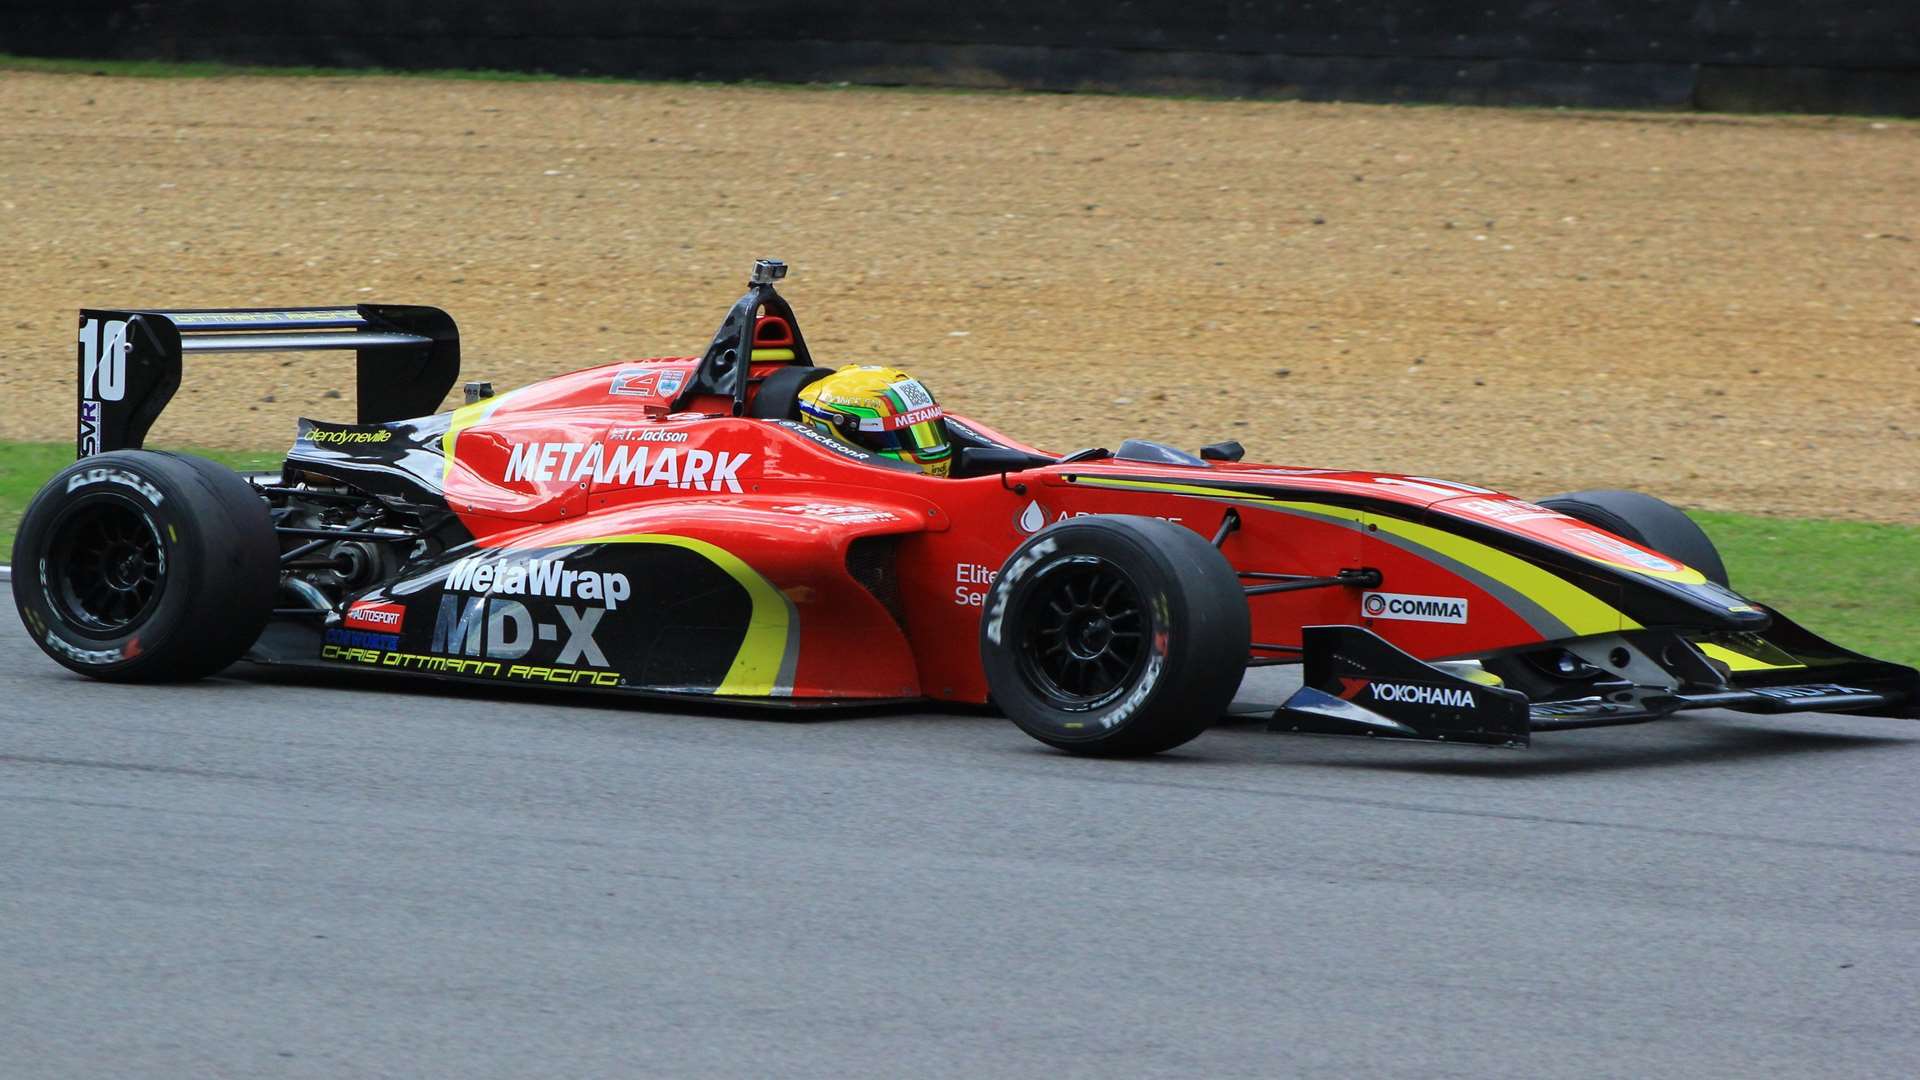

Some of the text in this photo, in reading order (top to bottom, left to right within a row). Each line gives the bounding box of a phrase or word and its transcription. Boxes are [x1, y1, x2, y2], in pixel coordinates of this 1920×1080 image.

[80, 318, 127, 401] 10
[80, 402, 98, 456] SVR
[304, 428, 392, 445] dendyneville
[625, 428, 688, 442] T. Jackson
[504, 442, 752, 494] METAMARK
[444, 557, 631, 610] MetaWrap
[957, 563, 999, 584] Elite
[1389, 599, 1462, 618] COMMA
[431, 593, 611, 668] MD-X
[321, 645, 620, 686] CHRIS DITTMANN RACING
[1370, 682, 1475, 709] YOKOHAMA
